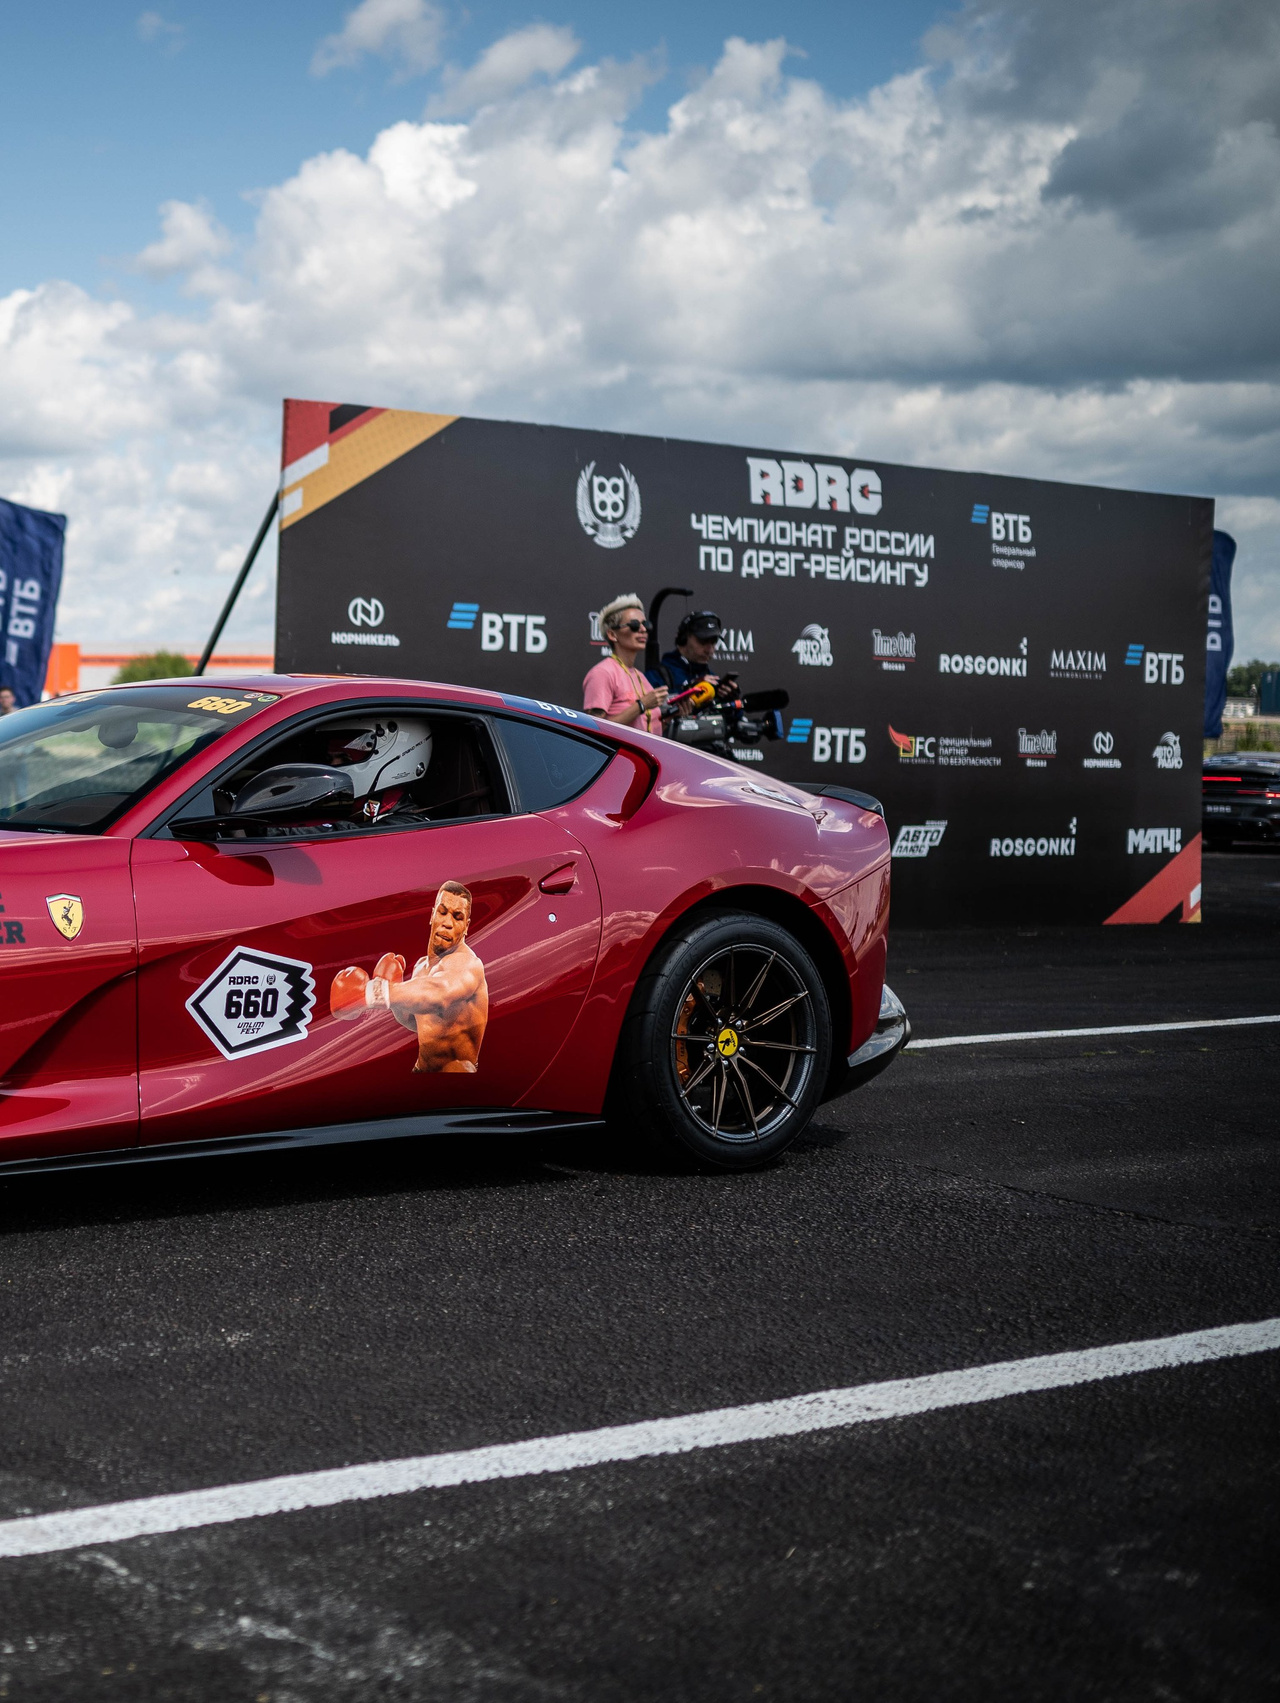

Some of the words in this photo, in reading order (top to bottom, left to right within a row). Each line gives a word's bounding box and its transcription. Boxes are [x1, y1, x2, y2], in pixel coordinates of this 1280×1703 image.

[747, 456, 882, 515] RDRC
[691, 513, 837, 549] ЧЕМПИОНАТ
[845, 526, 935, 558] РОССИИ
[992, 512, 1032, 543] ВТБ
[699, 545, 733, 573] ПО
[741, 547, 929, 588] ДРЭГ-РЕЙСИНГУ
[8, 578, 42, 641] ВТБ
[331, 632, 401, 647] НОРНИКЕЛЬ
[481, 612, 548, 653] ВТБ
[939, 653, 1028, 677] ROSGONKI
[1050, 650, 1107, 672] MAXIM
[1145, 652, 1185, 685] ВТБ
[187, 696, 252, 714] 660
[813, 726, 867, 764] ВТБ
[939, 737, 993, 748] ОФИЦИАЛЬНЫЙ
[939, 757, 948, 766] ПО
[900, 829, 941, 843] АВТО
[990, 837, 1076, 857] ROSGONKI
[1127, 827, 1182, 855] МАТЧ!
[228, 976, 259, 986] RDRC
[224, 987, 279, 1020] 660
